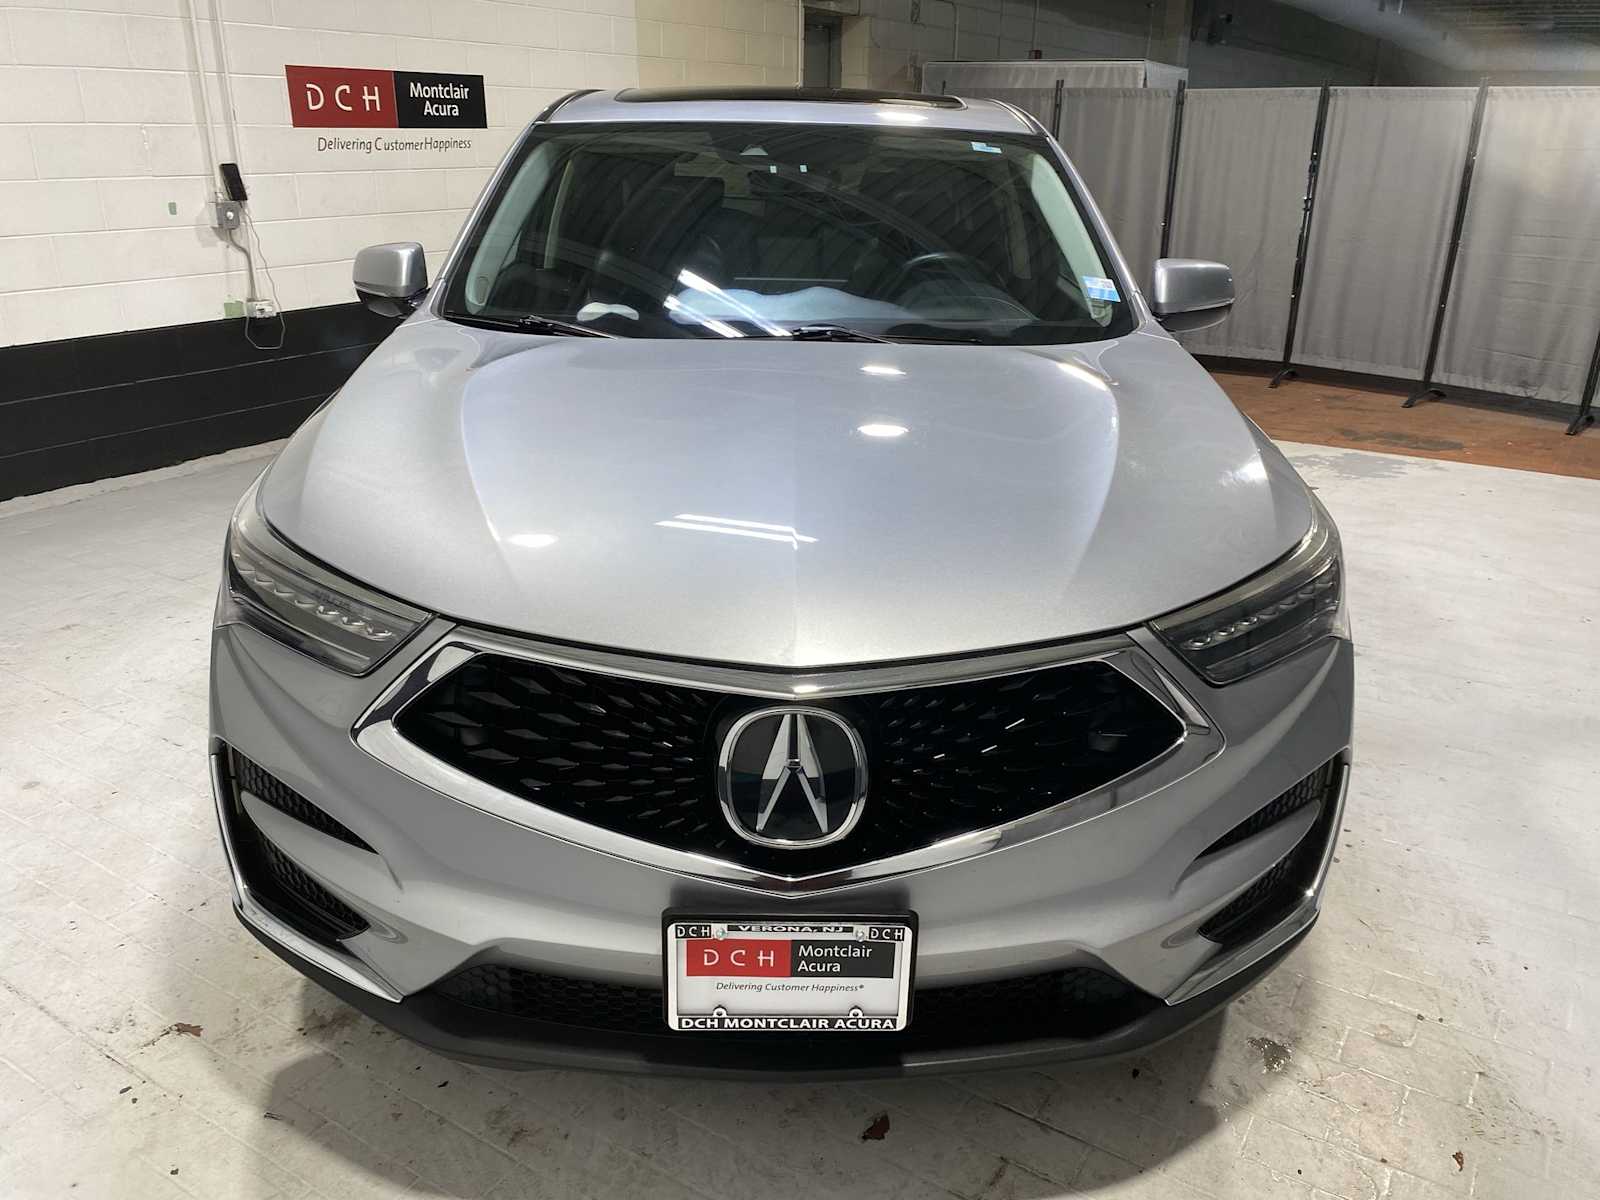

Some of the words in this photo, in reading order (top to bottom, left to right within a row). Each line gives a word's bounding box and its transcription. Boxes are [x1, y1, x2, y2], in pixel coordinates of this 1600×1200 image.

[410, 82, 469, 99] Montclair
[424, 101, 459, 116] Acura
[317, 137, 372, 154] Delivering
[738, 925, 818, 933] VERONA,
[798, 945, 873, 958] Montclair
[797, 960, 841, 973] Acura
[717, 982, 763, 992] Delivering
[765, 983, 809, 991] Customer
[682, 1019, 719, 1029] DCH
[724, 1019, 830, 1029] MONTCLAIR
[834, 1019, 894, 1029] ACURA
